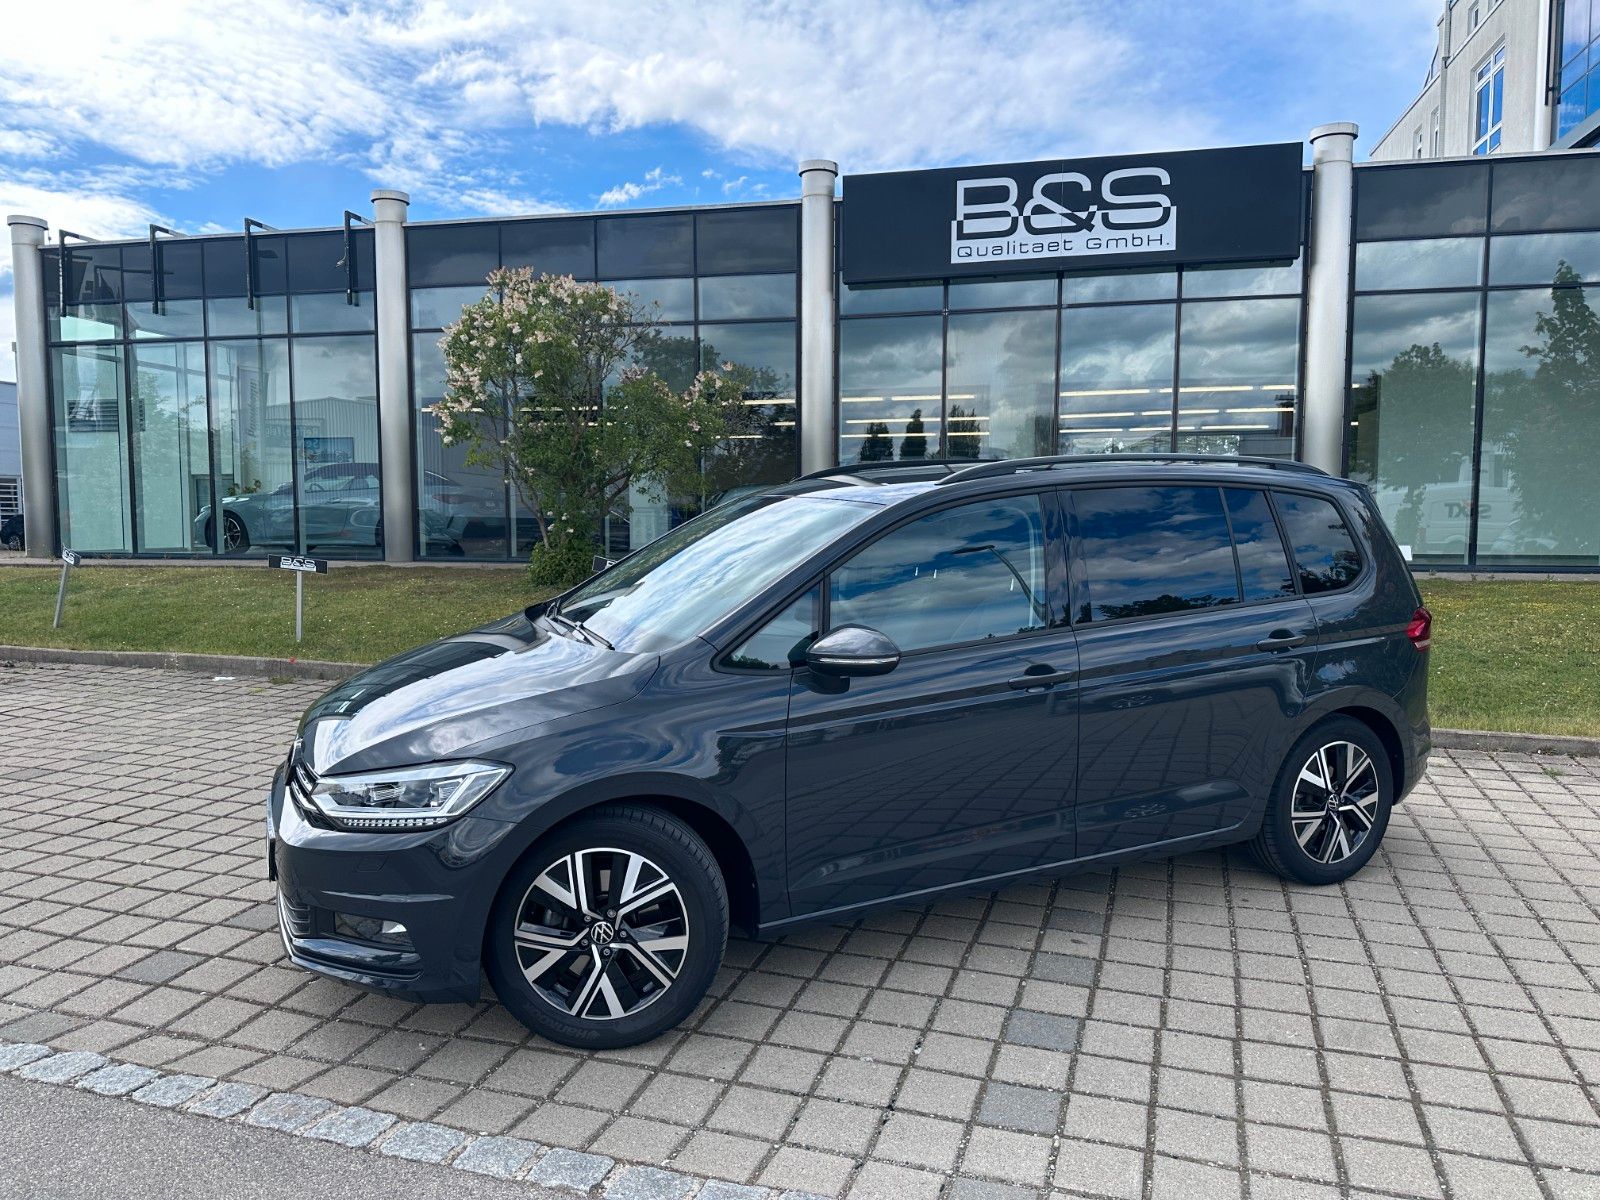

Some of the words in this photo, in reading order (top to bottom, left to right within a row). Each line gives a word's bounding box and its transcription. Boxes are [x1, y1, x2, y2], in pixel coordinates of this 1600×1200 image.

[957, 167, 1171, 240] B&S
[957, 238, 1074, 258] Qualitaet
[1086, 233, 1170, 250] GmbH.
[281, 557, 316, 569] B&S
